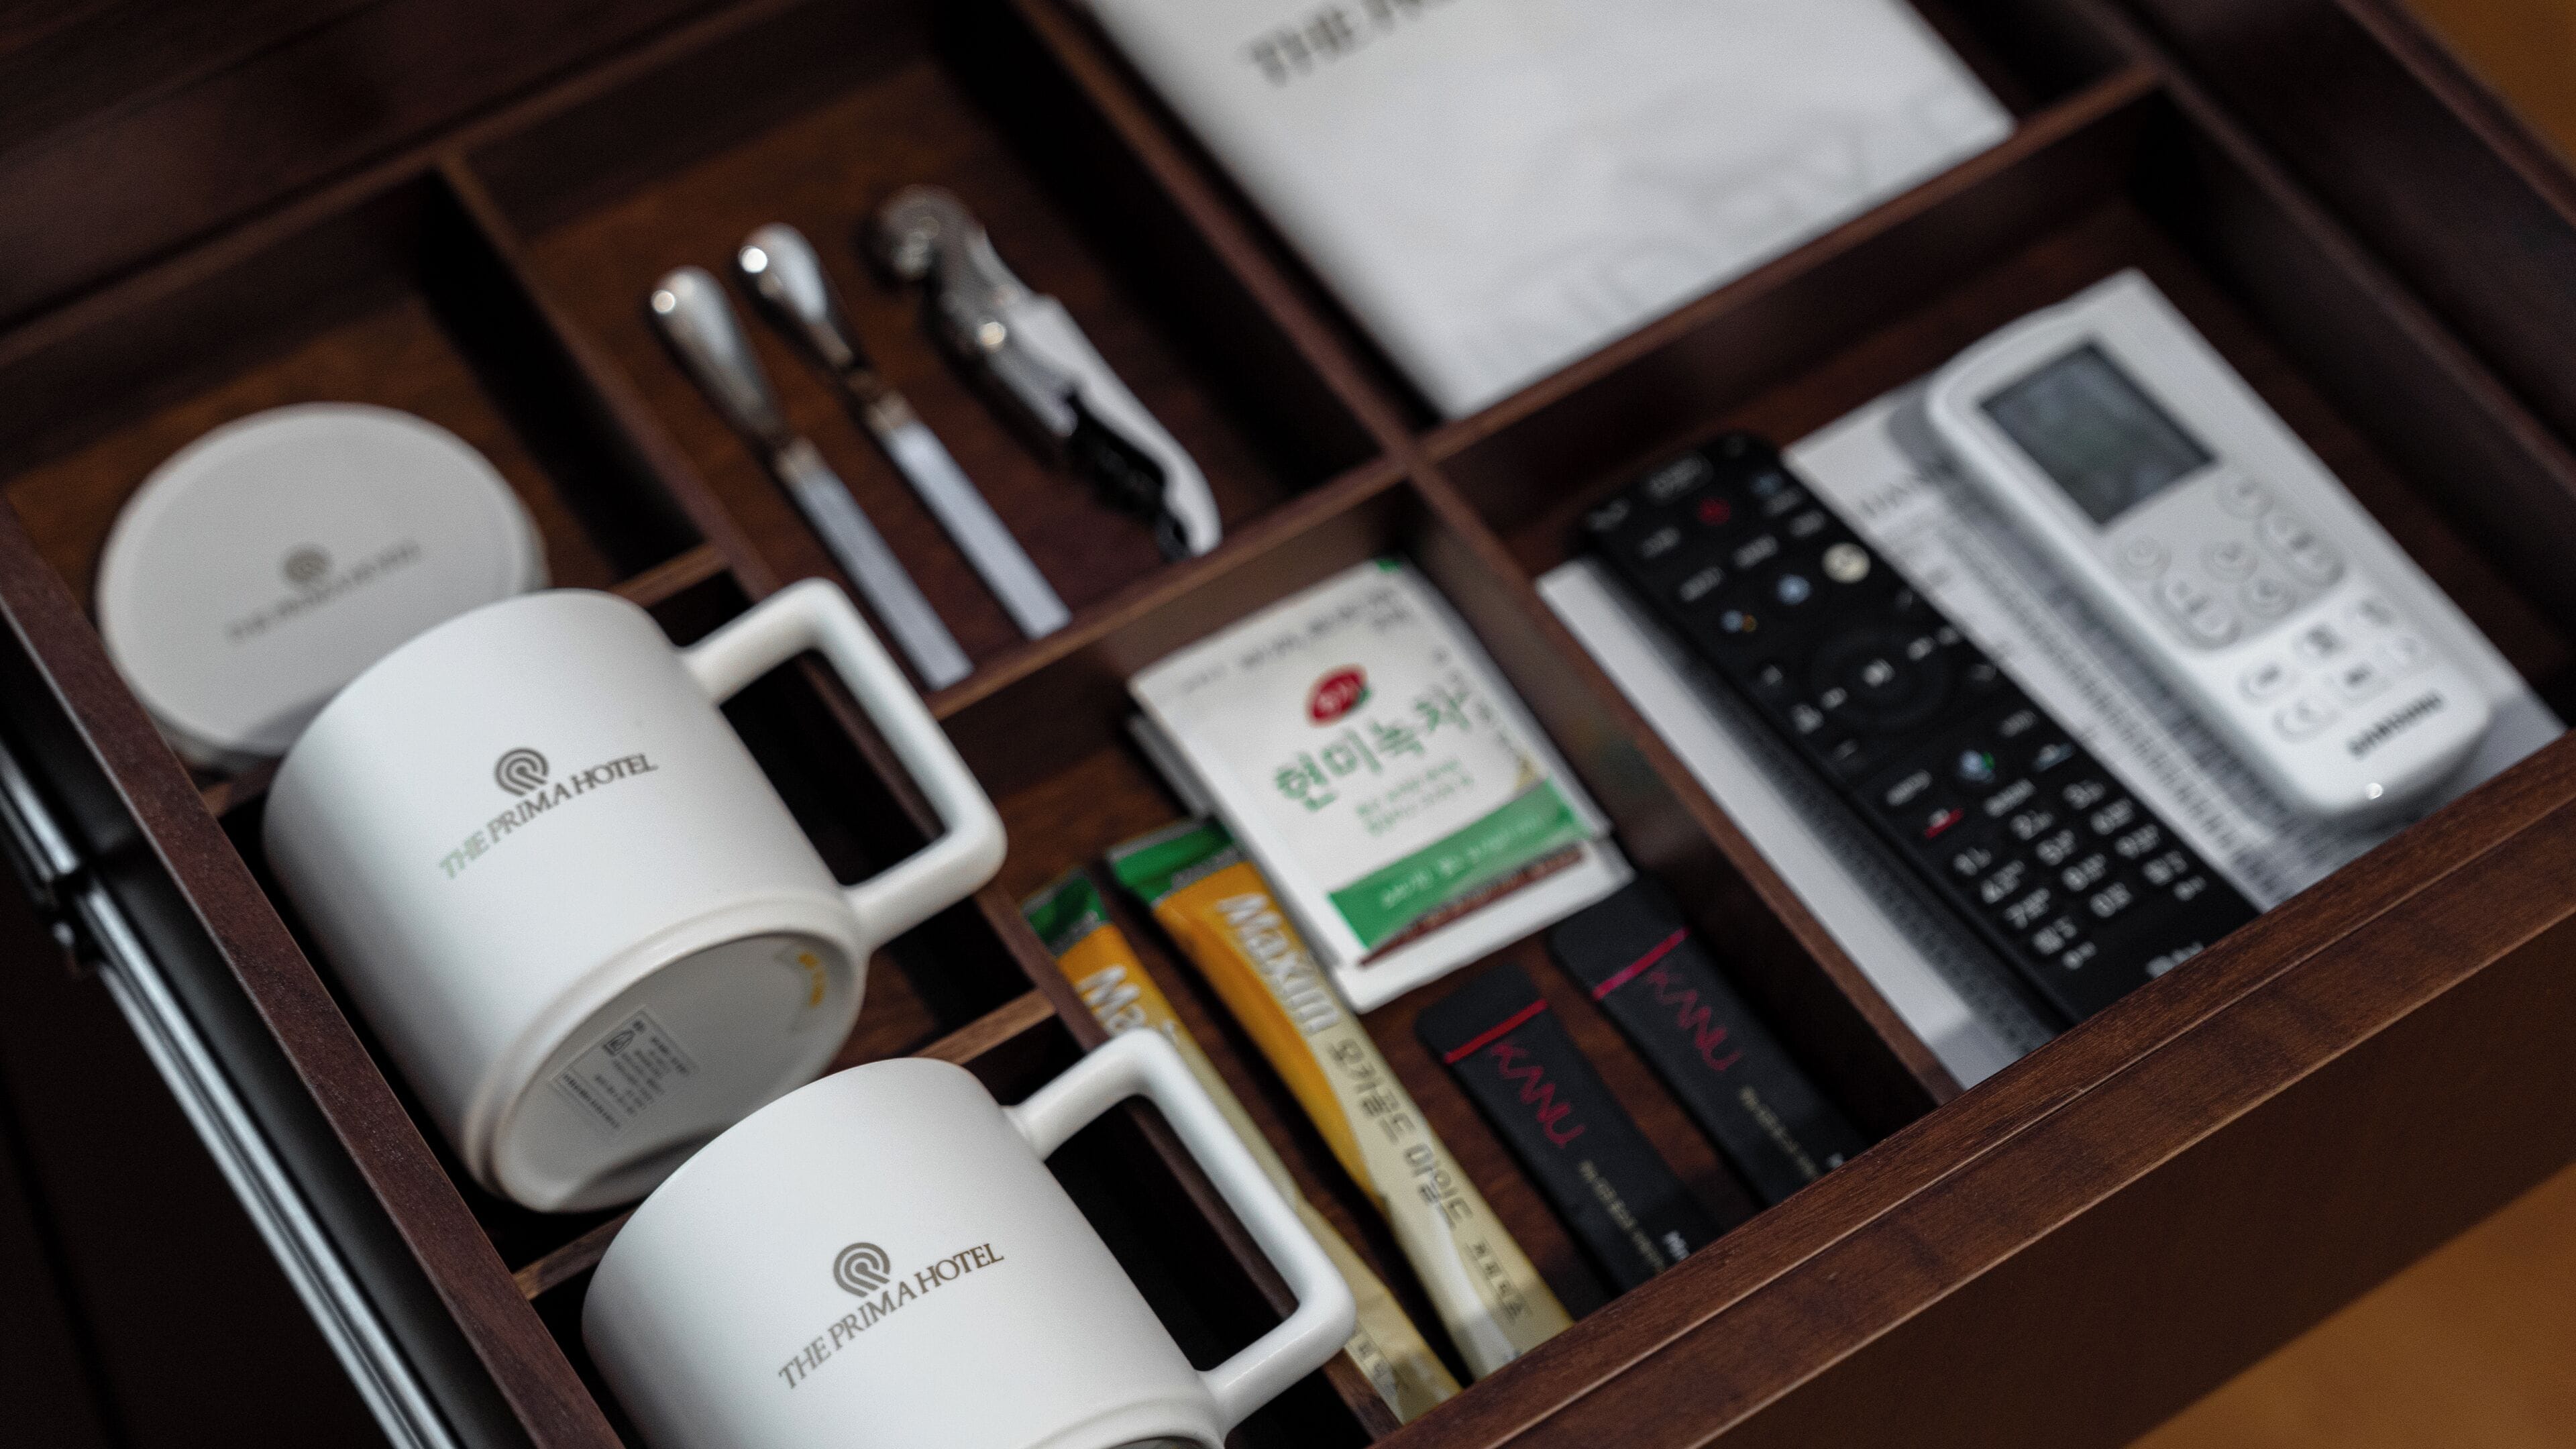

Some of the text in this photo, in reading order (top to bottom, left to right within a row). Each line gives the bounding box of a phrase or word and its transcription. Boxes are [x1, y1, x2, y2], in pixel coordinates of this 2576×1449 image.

[1274, 691, 1472, 812] 현미녹차
[439, 753, 659, 880] THE PRIMA HOTEL
[1215, 892, 1341, 1034] Maxim
[1646, 969, 1742, 1071] KANU
[1328, 1039, 1474, 1230] 모카골드 마일드
[1489, 1038, 1586, 1149] KANU
[778, 1243, 1004, 1389] THE PRIMA HOTEL
